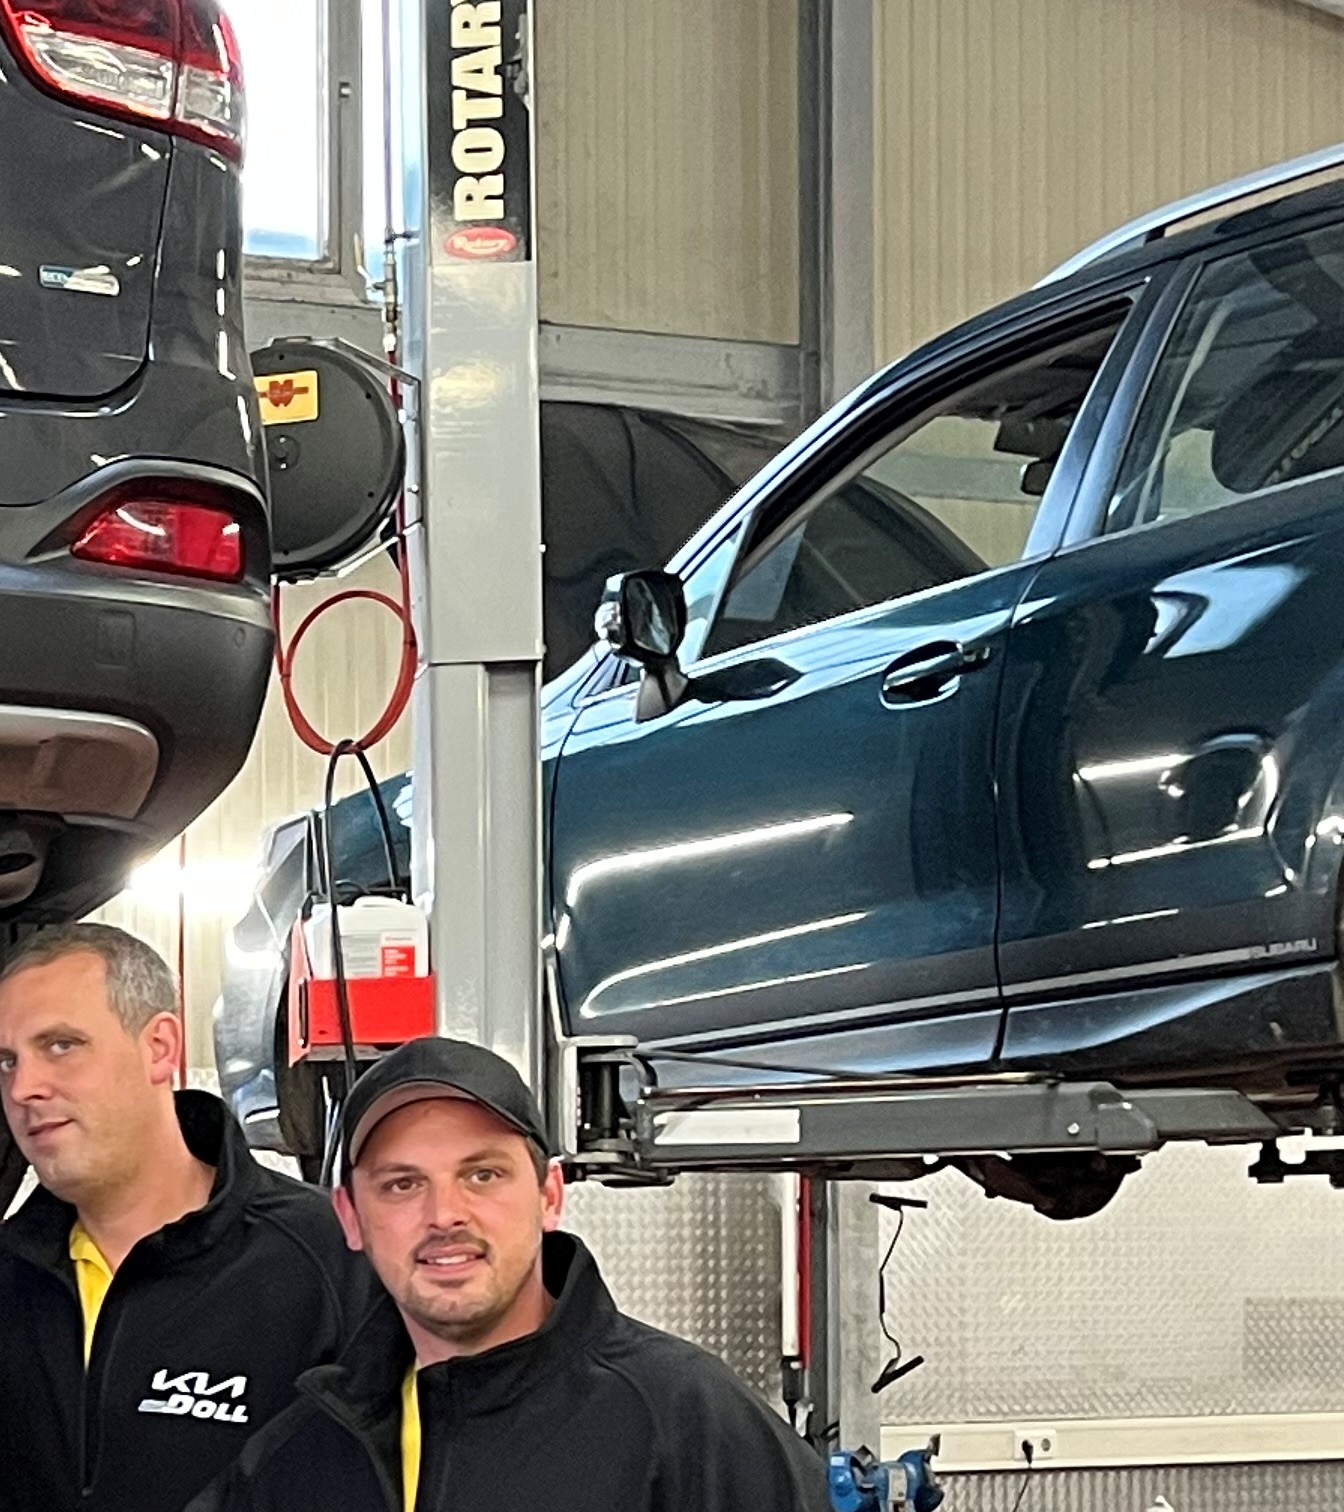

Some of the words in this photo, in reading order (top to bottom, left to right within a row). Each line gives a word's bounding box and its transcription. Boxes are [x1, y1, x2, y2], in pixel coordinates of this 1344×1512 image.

[451, 0, 505, 221] ROTAR
[1250, 937, 1317, 959] SUBARU
[151, 1368, 247, 1399] KIA
[155, 1393, 249, 1423] DOLL
